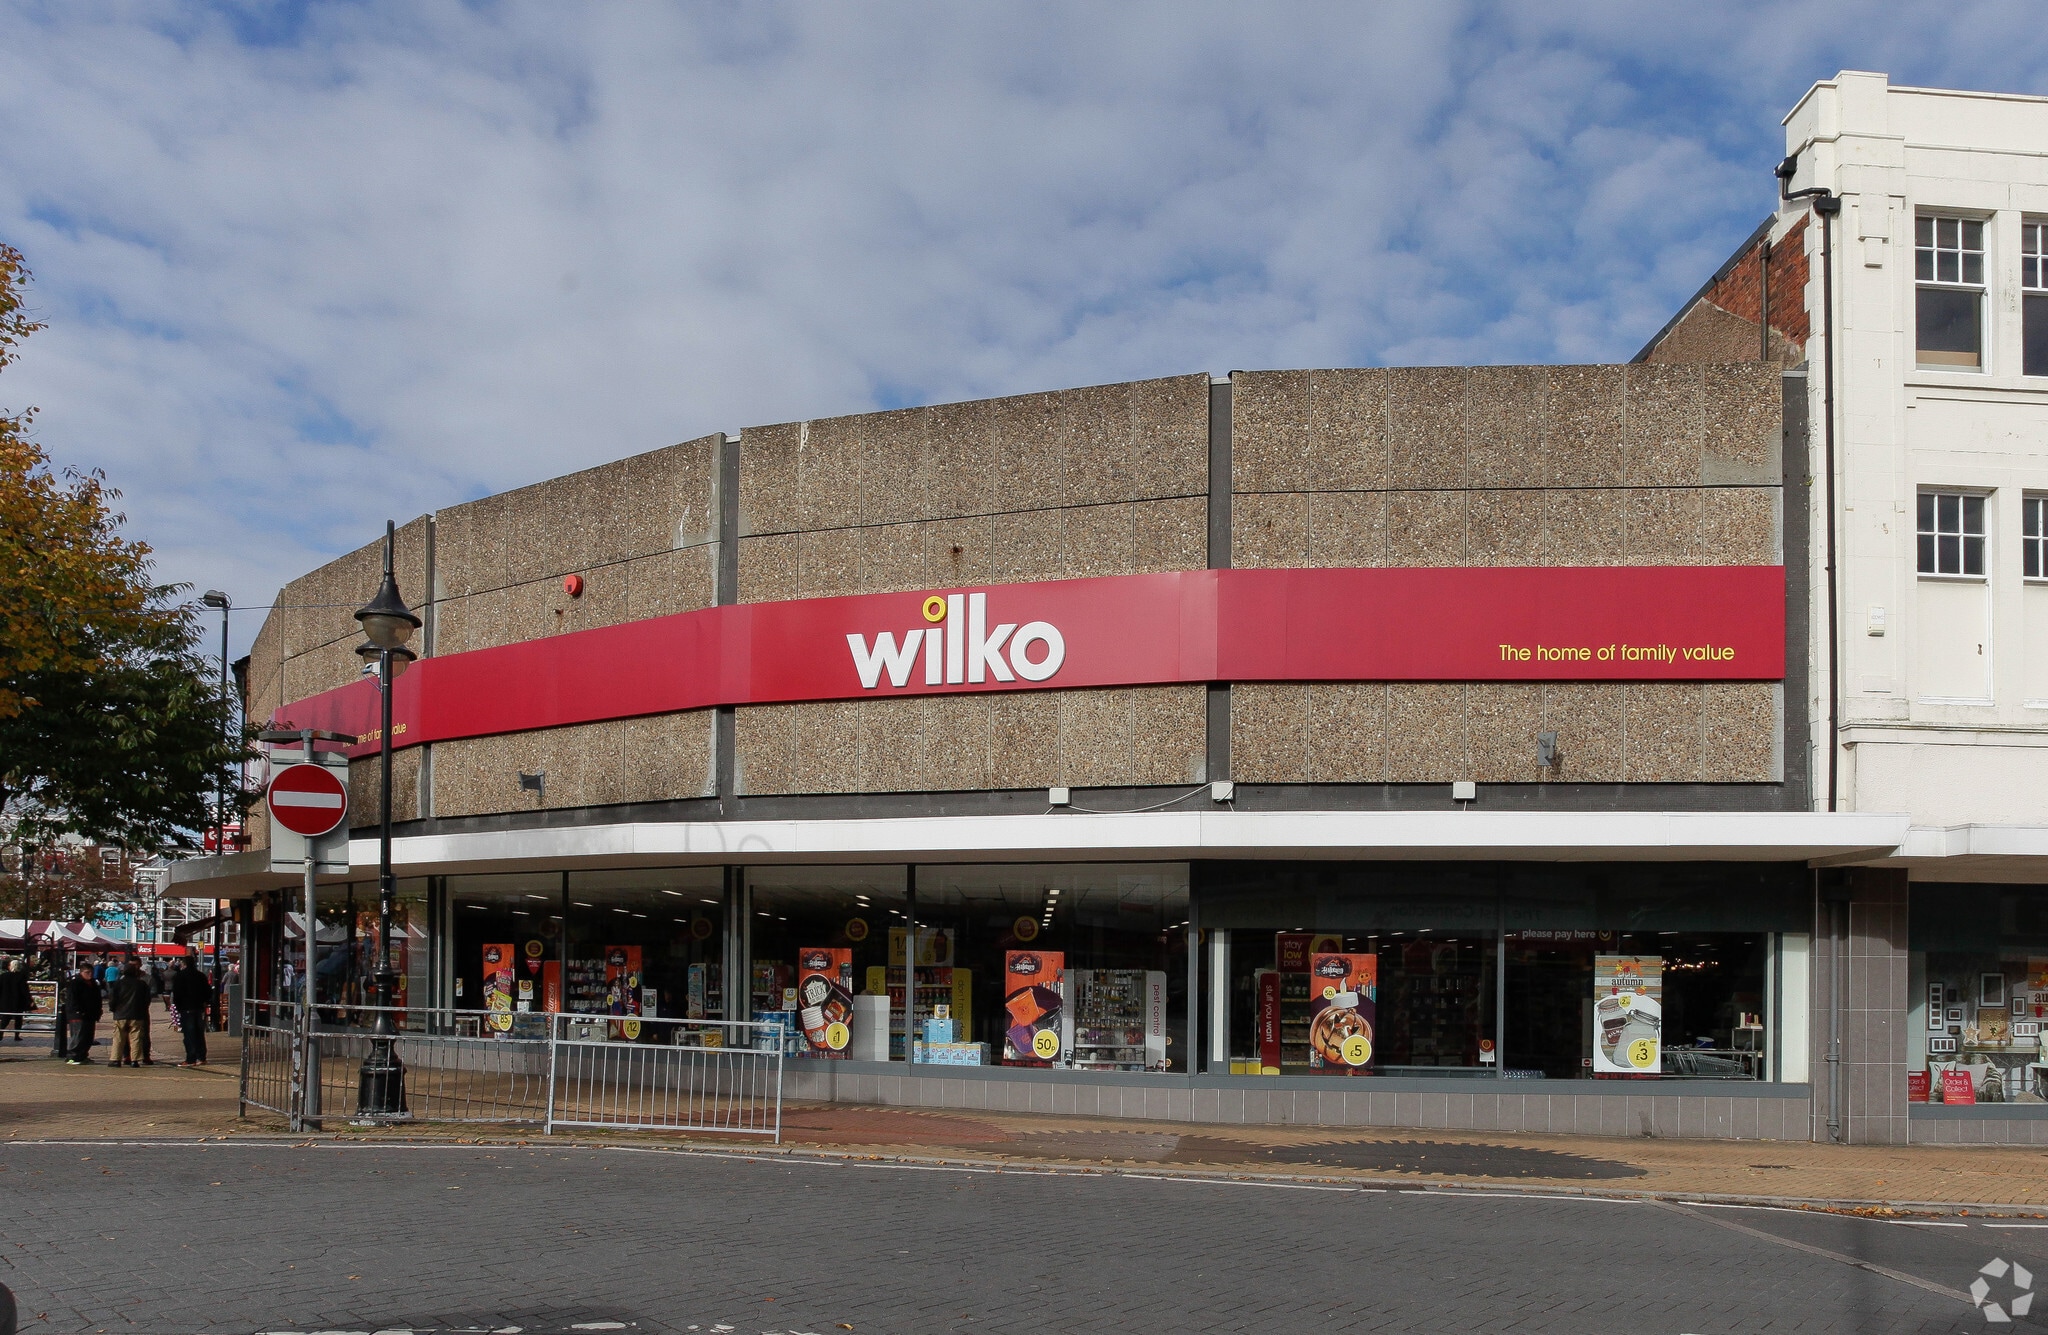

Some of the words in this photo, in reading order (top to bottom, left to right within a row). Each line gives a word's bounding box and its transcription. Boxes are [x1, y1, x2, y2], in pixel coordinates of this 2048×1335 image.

[846, 592, 1066, 689] wilko
[1499, 644, 1531, 661] The
[1537, 644, 1591, 661] home
[1597, 644, 1615, 661] of
[1621, 644, 1677, 664] family
[1683, 644, 1735, 661] value
[1522, 929, 1552, 940] please
[1555, 930, 1572, 940] pay
[1574, 929, 1596, 938] here
[1284, 940, 1303, 951] stay
[1284, 949, 1303, 959] low
[1284, 959, 1303, 967] price
[1612, 977, 1644, 986] autumn
[1153, 984, 1161, 1003] pest
[1265, 985, 1274, 1001] stuff
[1264, 1003, 1273, 1019] you
[1153, 1005, 1161, 1037] control
[833, 1030, 840, 1042] £1
[1265, 1020, 1274, 1042] want
[1037, 1038, 1056, 1052] 50p
[1350, 1044, 1363, 1057] £5
[1636, 1048, 1648, 1061] £3
[1945, 1085, 1968, 1093] Collect
